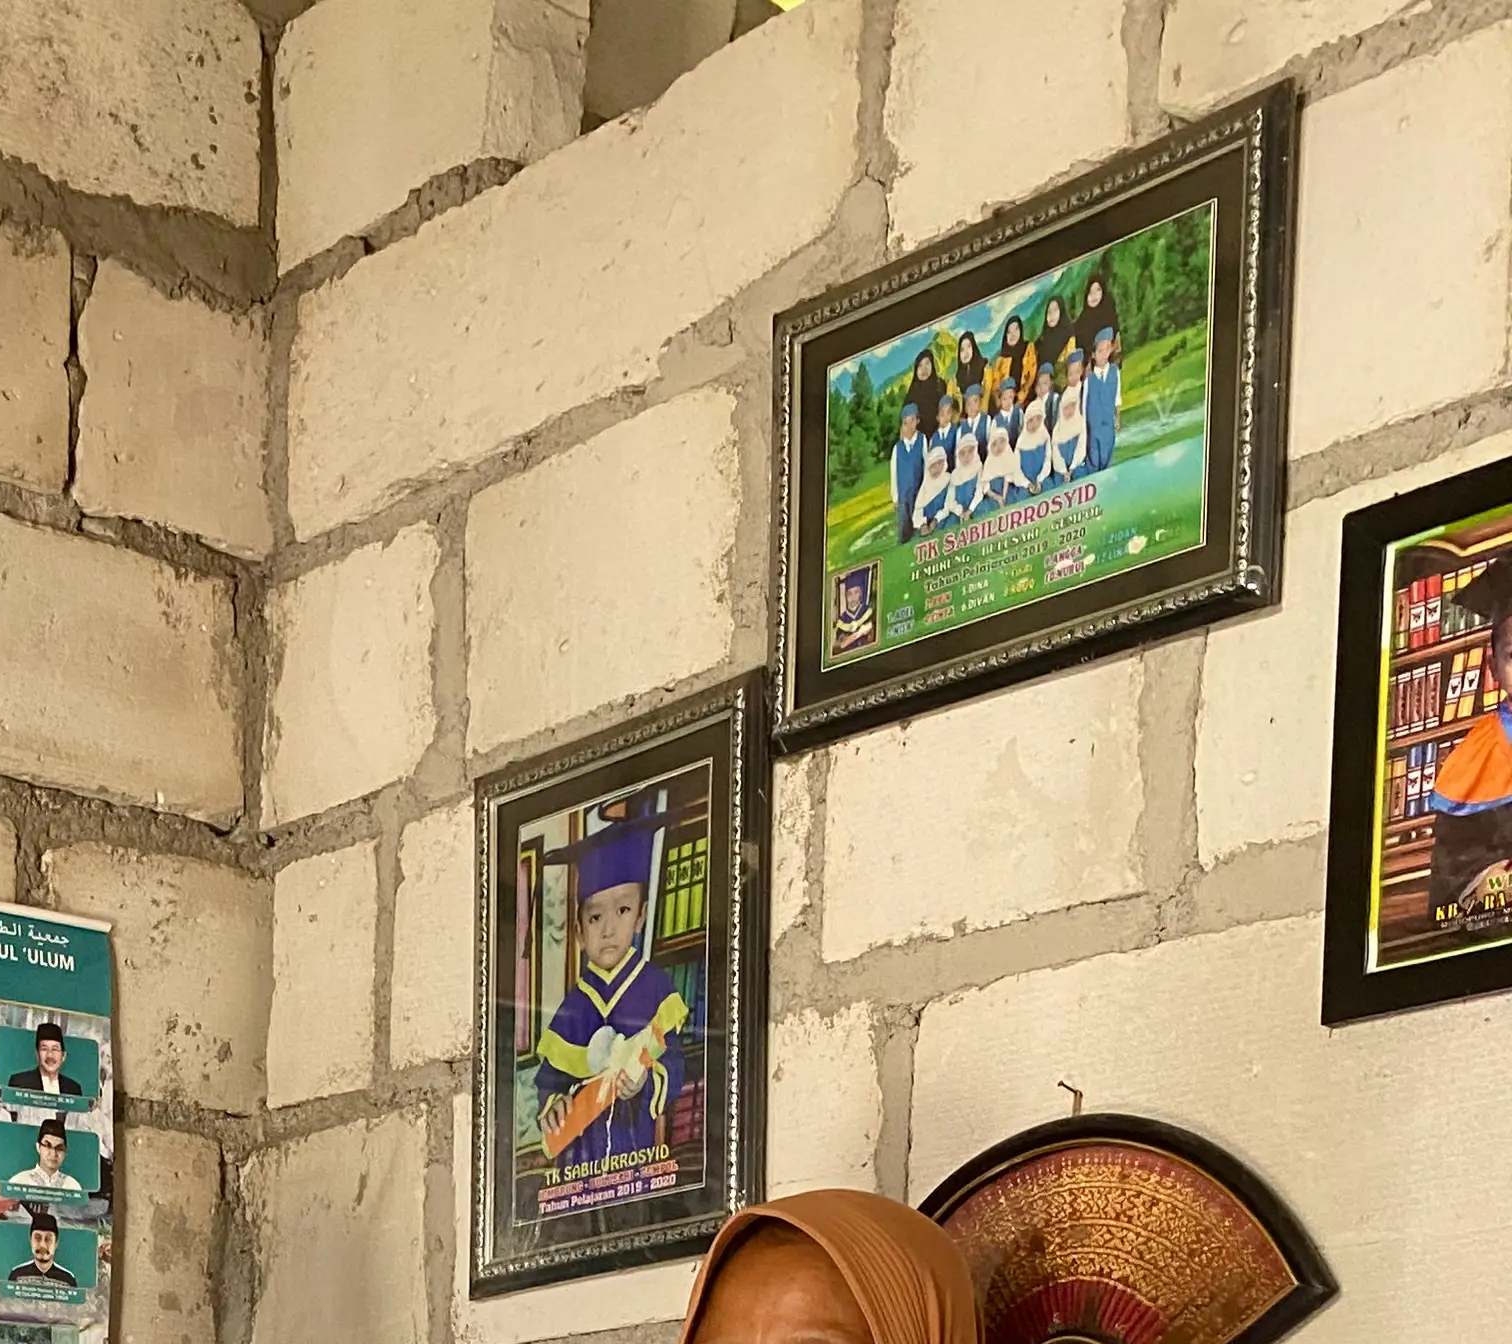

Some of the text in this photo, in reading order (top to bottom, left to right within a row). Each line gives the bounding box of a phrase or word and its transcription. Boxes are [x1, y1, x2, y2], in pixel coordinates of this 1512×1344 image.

[914, 540, 939, 564] TK
[943, 483, 1097, 555] SABILURROSYID
[925, 572, 960, 593] Tahun
[1022, 540, 1048, 559] 2019
[1059, 527, 1086, 546] 2020
[28, 924, 70, 948] جمعية
[545, 1144, 669, 1186] TK SABILURROSYID
[539, 1200, 569, 1214] Tahun
[571, 1189, 616, 1207] Pelajaran
[617, 1181, 643, 1197] 2019
[650, 1174, 676, 1190] 2020
